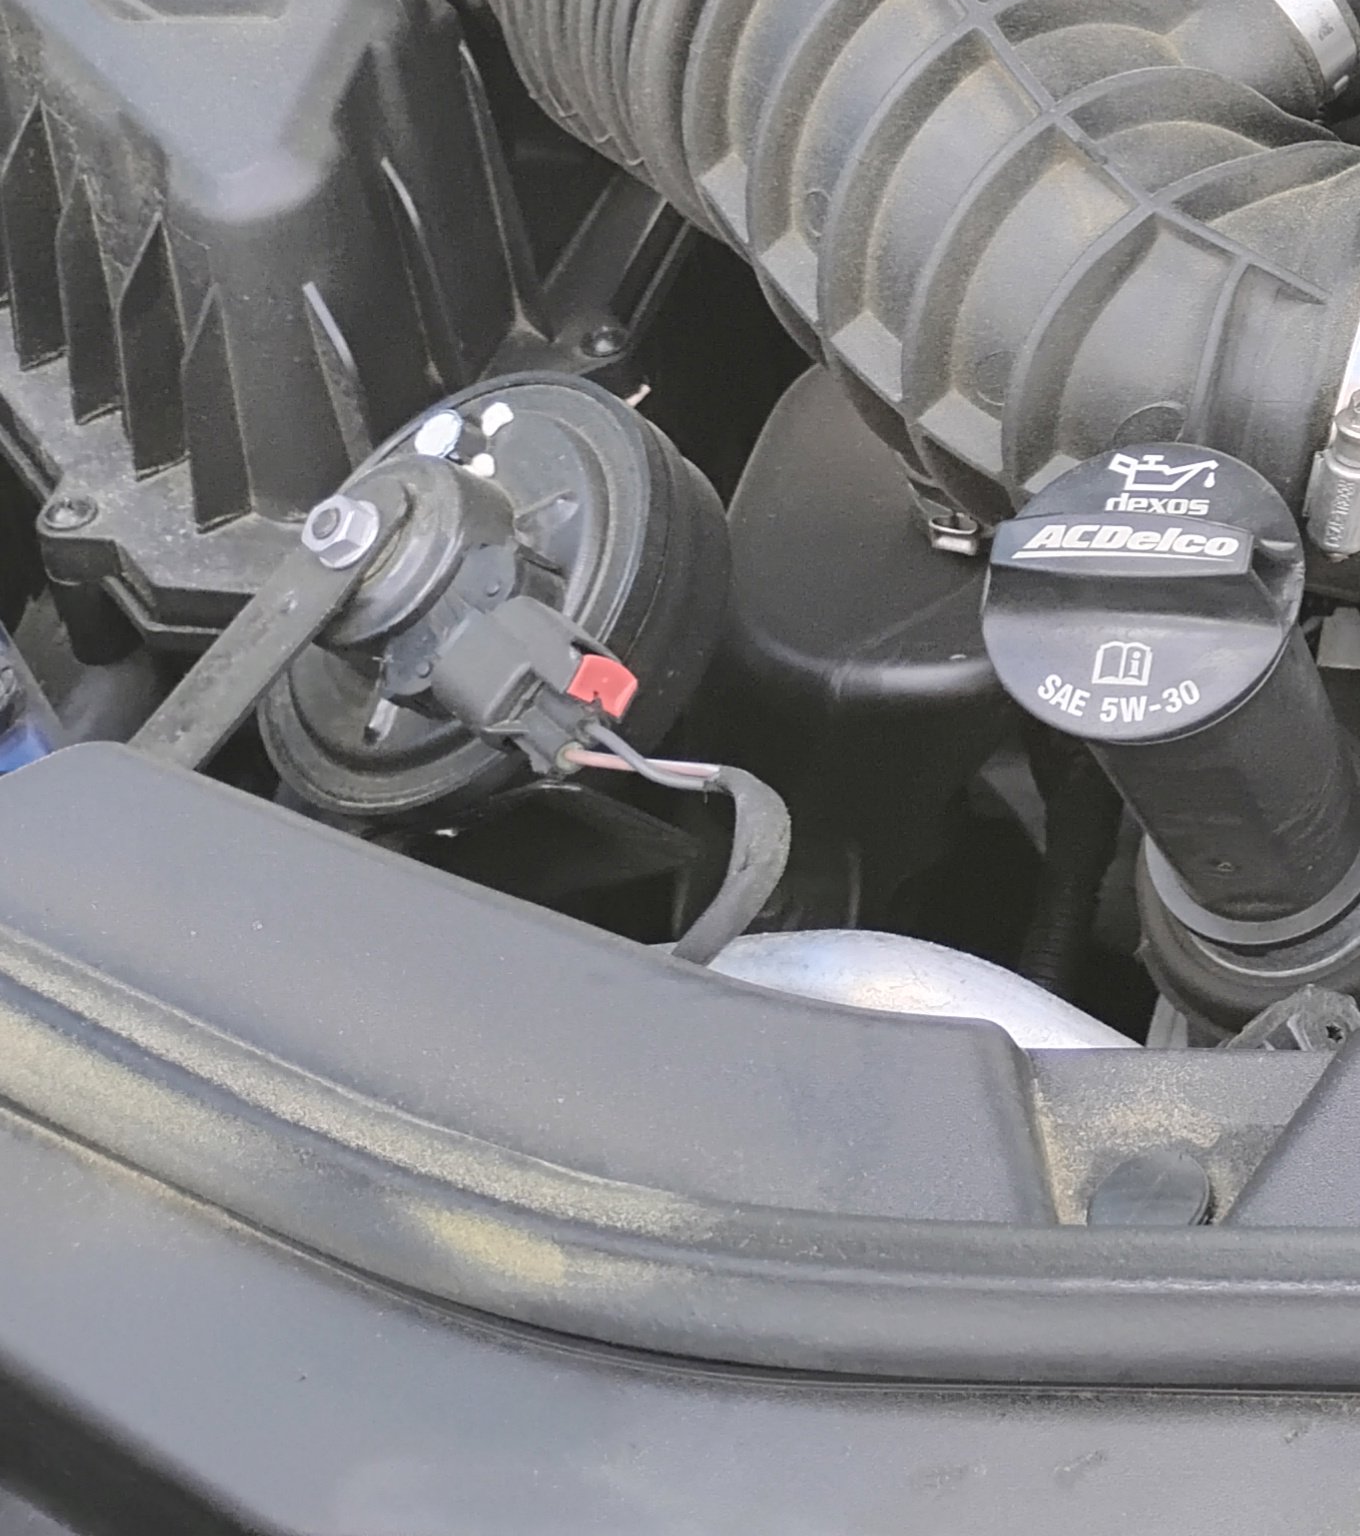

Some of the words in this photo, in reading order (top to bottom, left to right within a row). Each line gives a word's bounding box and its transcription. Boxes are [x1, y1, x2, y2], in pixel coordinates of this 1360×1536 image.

[1105, 492, 1211, 516] dexos
[1022, 524, 1240, 557] ACDelco
[1037, 674, 1091, 717] SAE
[1099, 680, 1200, 722] 5W-30
